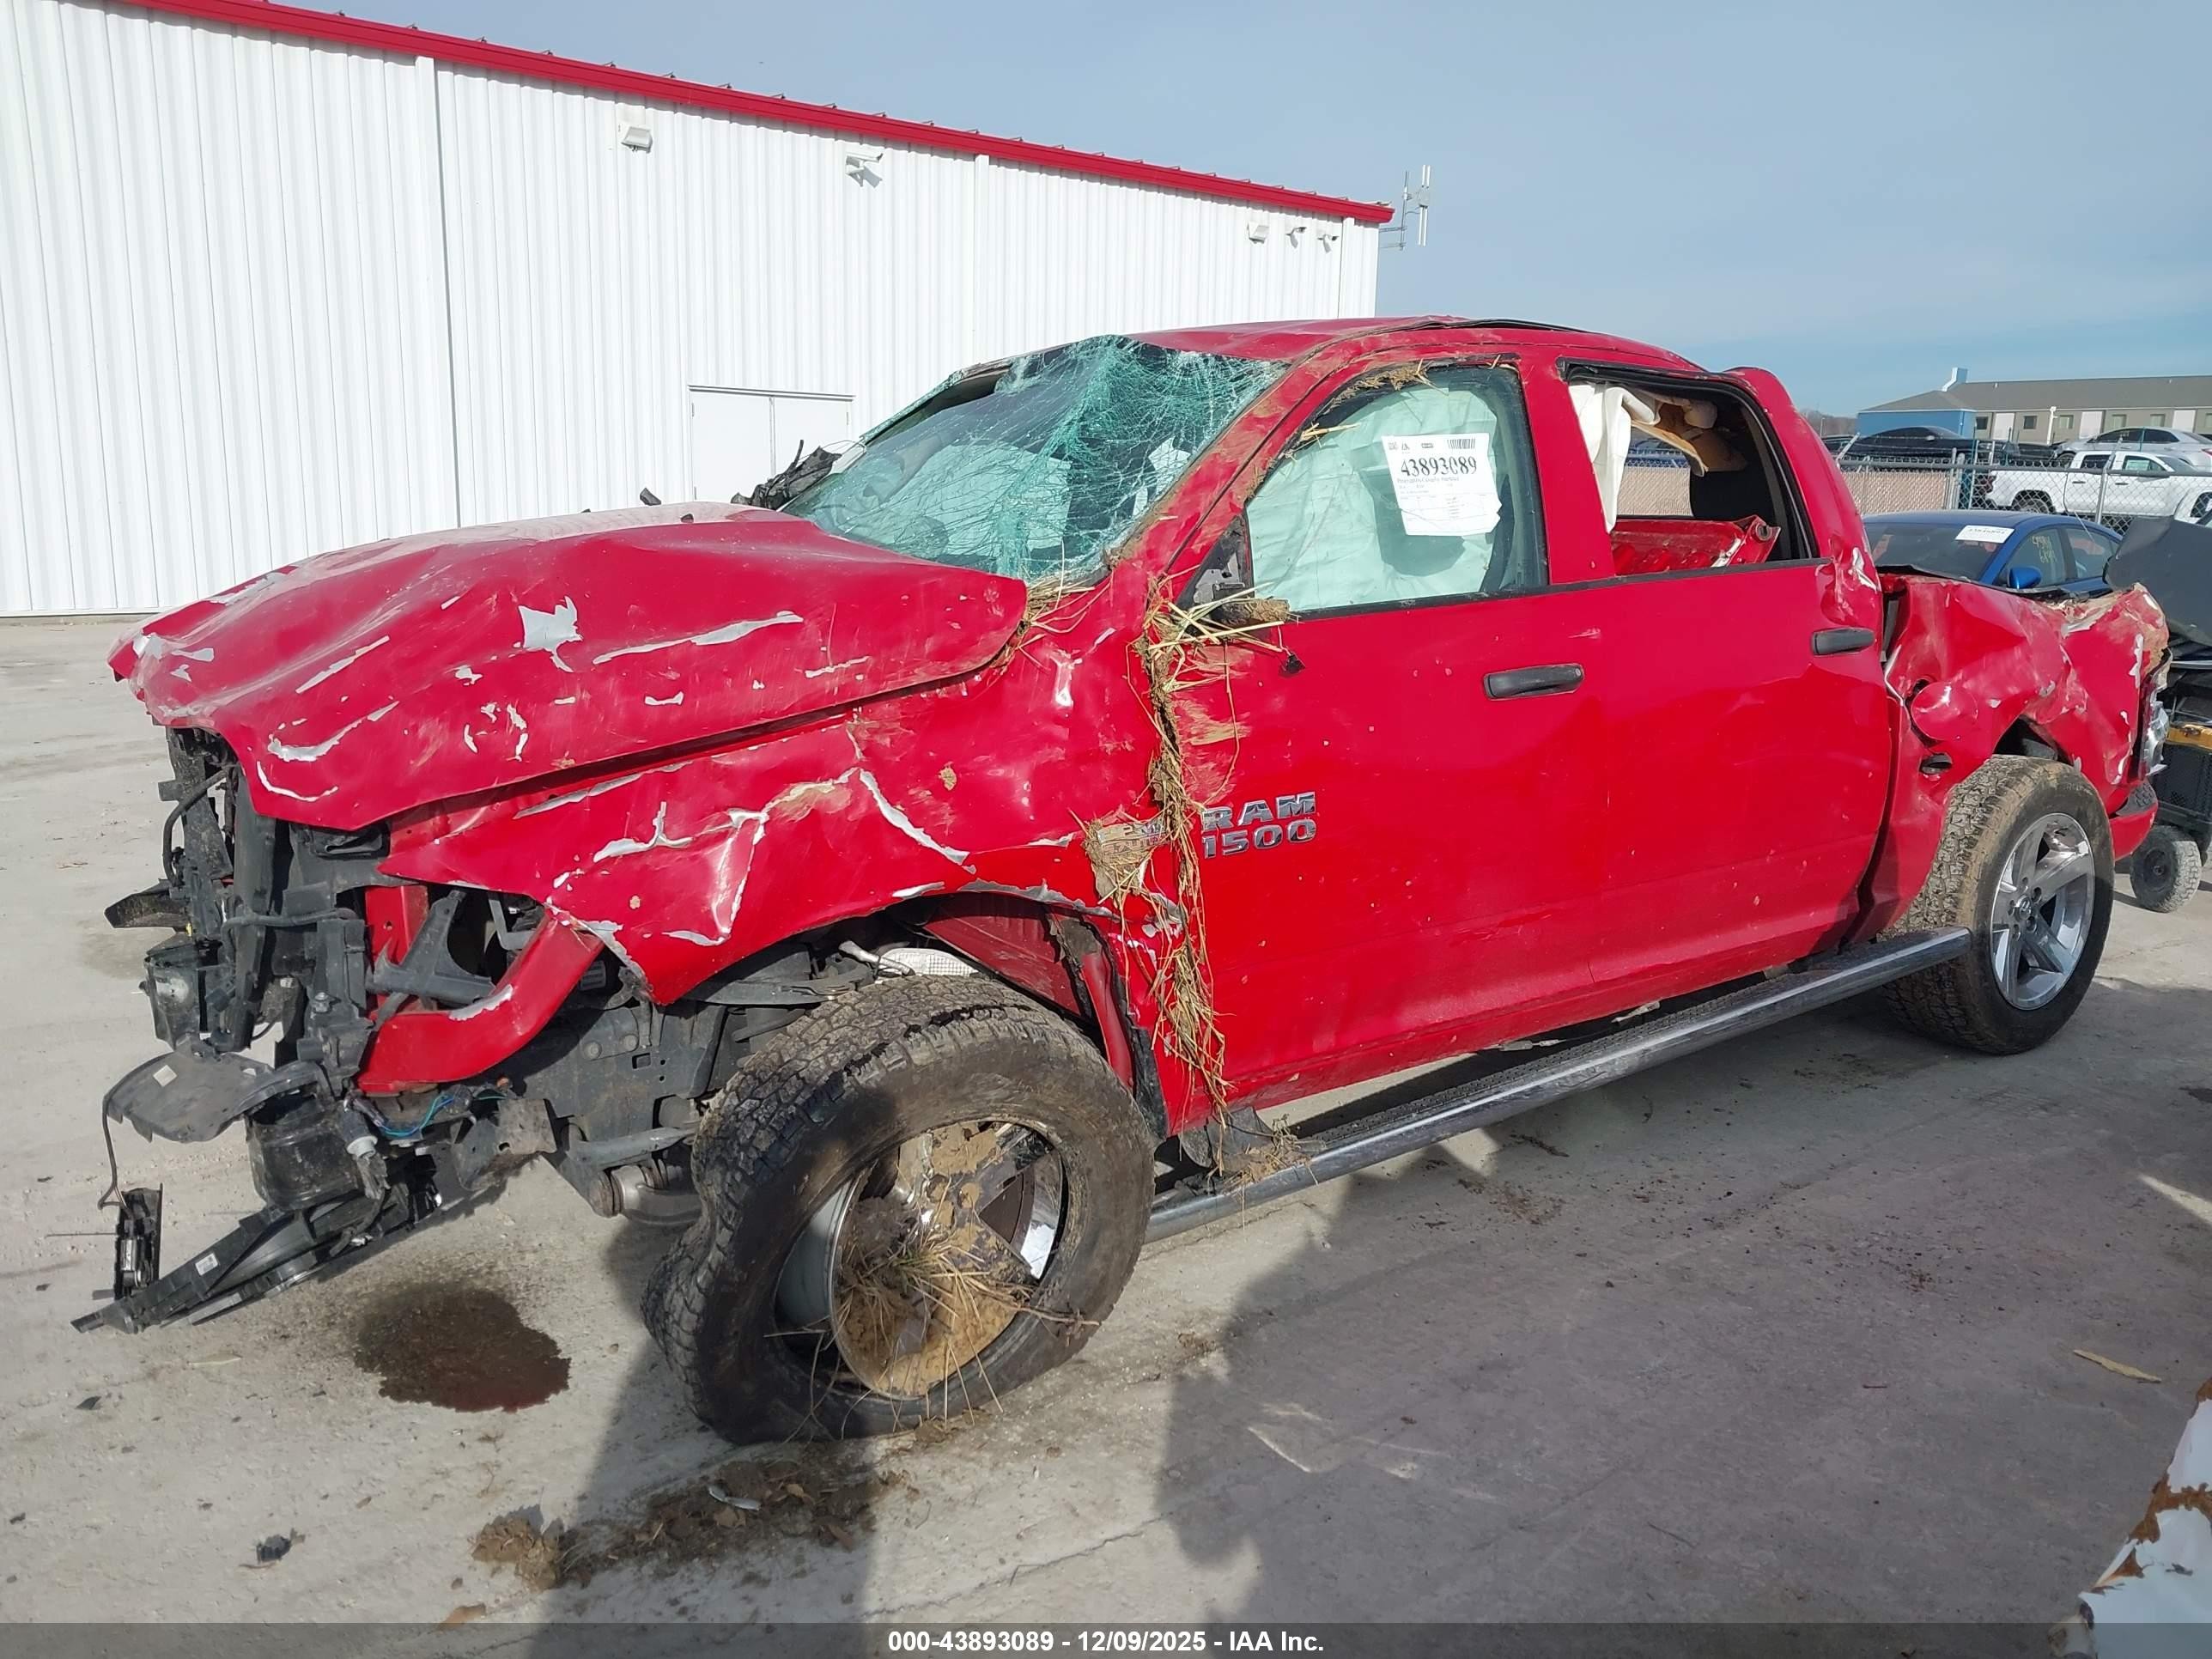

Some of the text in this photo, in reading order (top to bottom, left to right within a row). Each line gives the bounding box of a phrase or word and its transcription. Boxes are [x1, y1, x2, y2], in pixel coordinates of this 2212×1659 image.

[1401, 455, 1477, 477] 43893089
[1200, 791, 1316, 832] RAM
[1201, 818, 1317, 860] 1500
